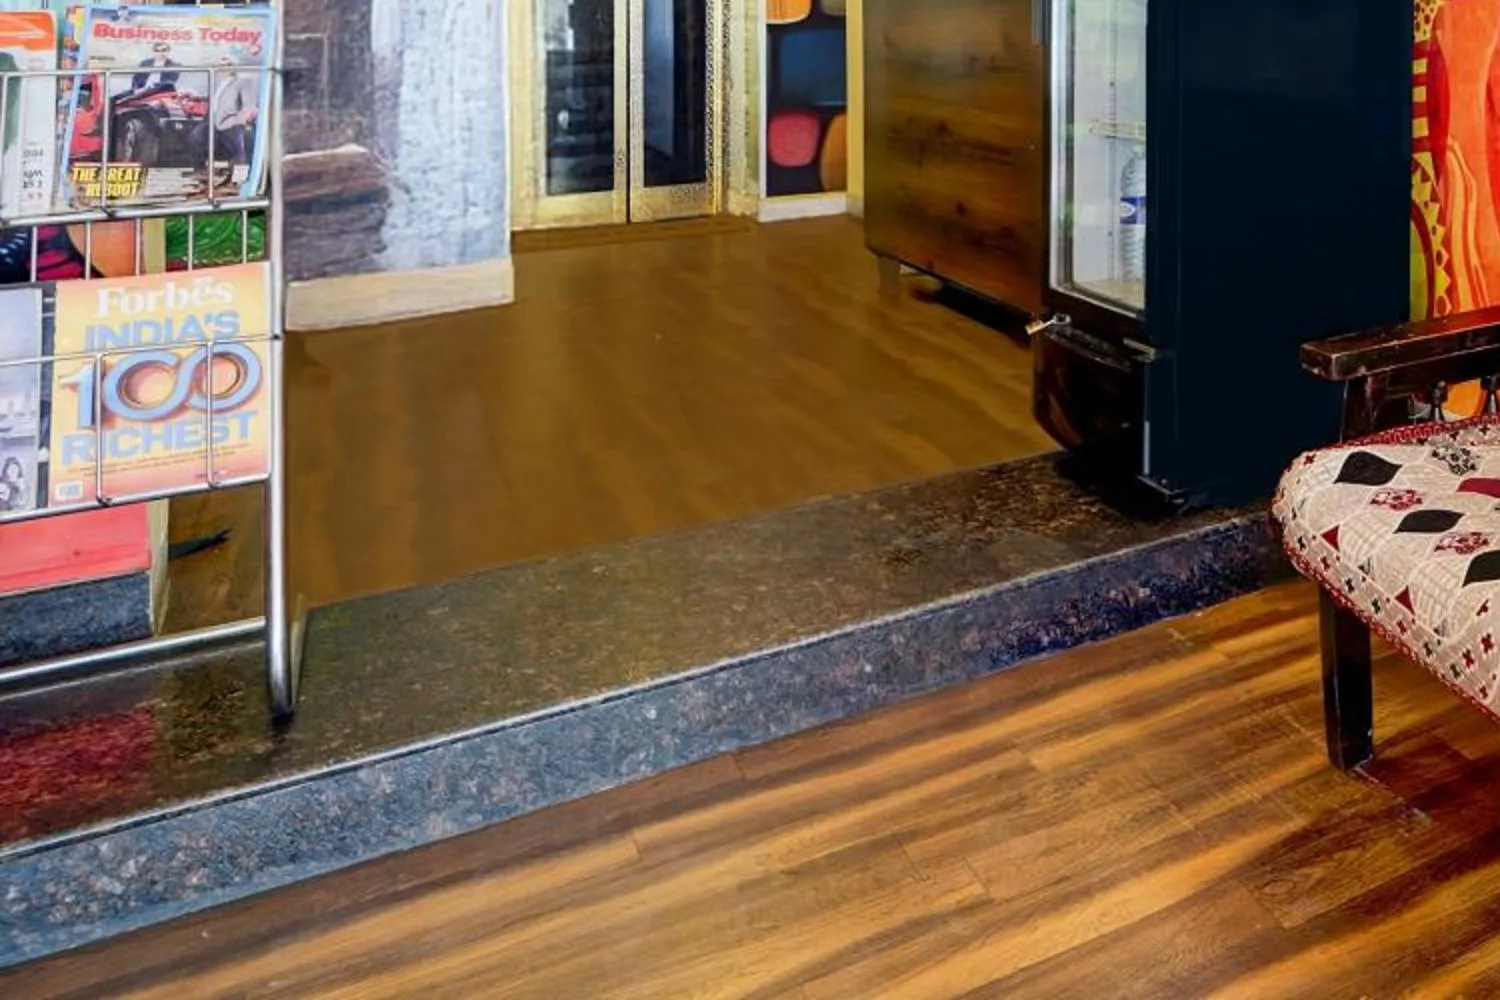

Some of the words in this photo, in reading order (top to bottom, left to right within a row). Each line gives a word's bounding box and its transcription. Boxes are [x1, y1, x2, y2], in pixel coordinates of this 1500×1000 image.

[93, 23, 193, 41] Business
[197, 27, 262, 55] Today
[72, 167, 98, 181] THE
[98, 167, 141, 181] REAT
[97, 278, 235, 317] Forbes
[86, 311, 240, 352] INDIA'S
[60, 343, 261, 430] 100
[62, 411, 257, 468] RICHEST
